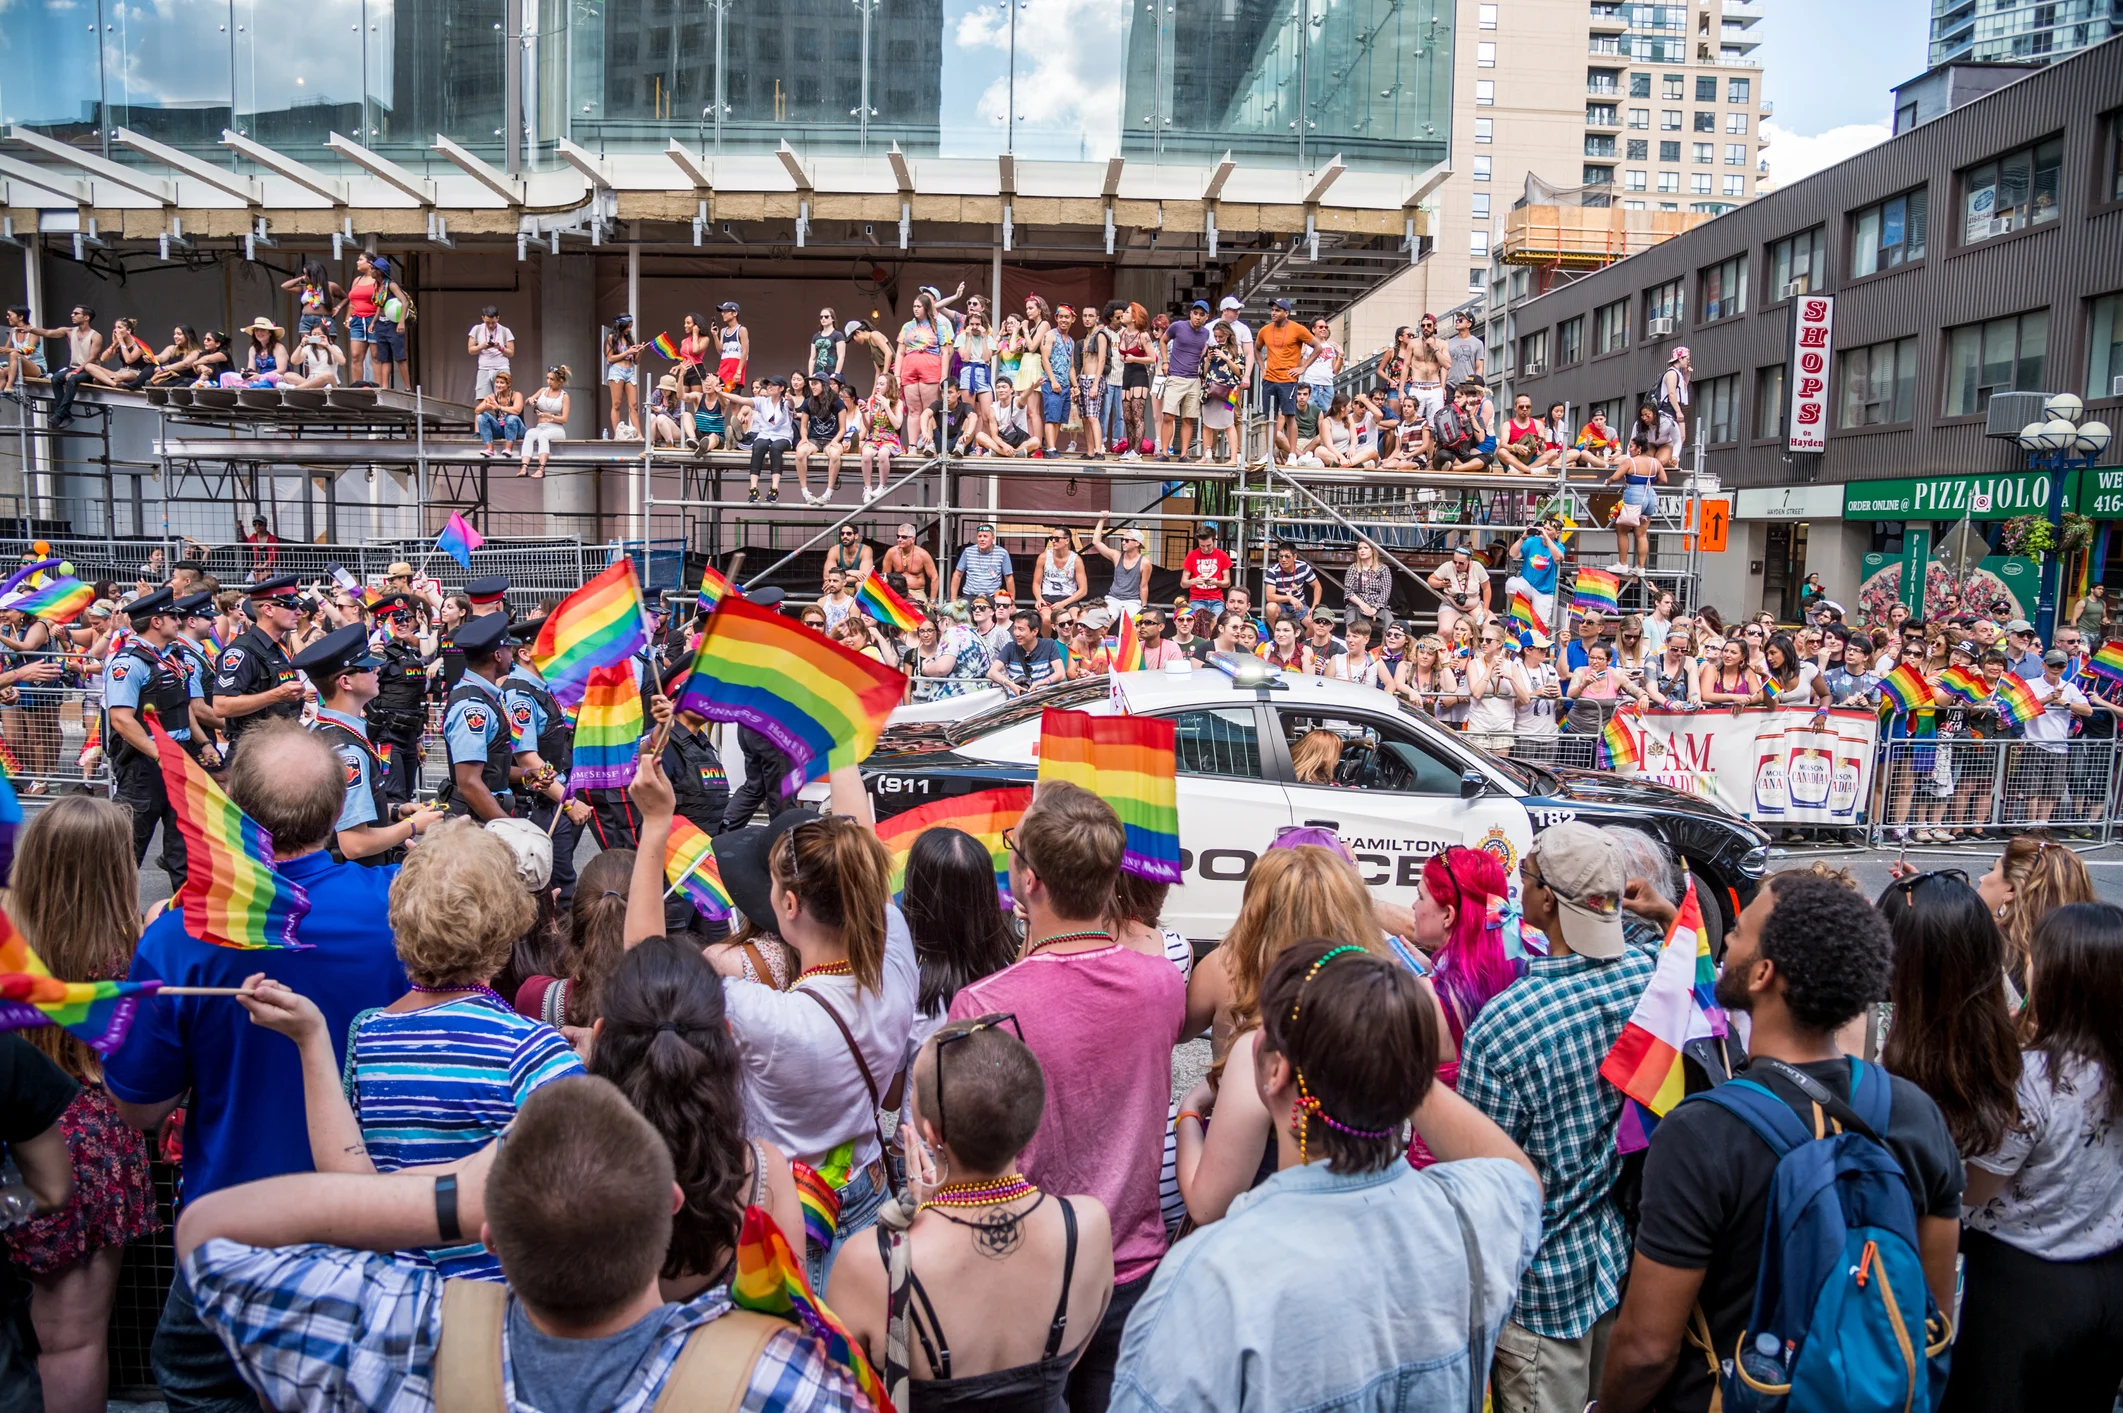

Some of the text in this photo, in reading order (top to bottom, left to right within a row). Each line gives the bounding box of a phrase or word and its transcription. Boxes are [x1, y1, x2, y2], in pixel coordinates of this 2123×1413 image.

[1797, 300, 1828, 424] SHOPS
[1790, 438, 1824, 448] Hayden
[1783, 489, 1791, 508] 7
[1848, 500, 1871, 511] ORDER
[1872, 499, 1899, 511] ONLINE
[1767, 507, 1804, 516] HAYDEN STREET
[698, 700, 763, 723] WINNERS
[1636, 730, 1648, 772] I
[1799, 764, 1825, 772] MOLSON
[1792, 771, 1829, 785] CANADIAN
[1534, 809, 1577, 828] 182
[1339, 837, 1446, 852] HAMILTON
[1771, 1061, 1808, 1085] LUMIX
